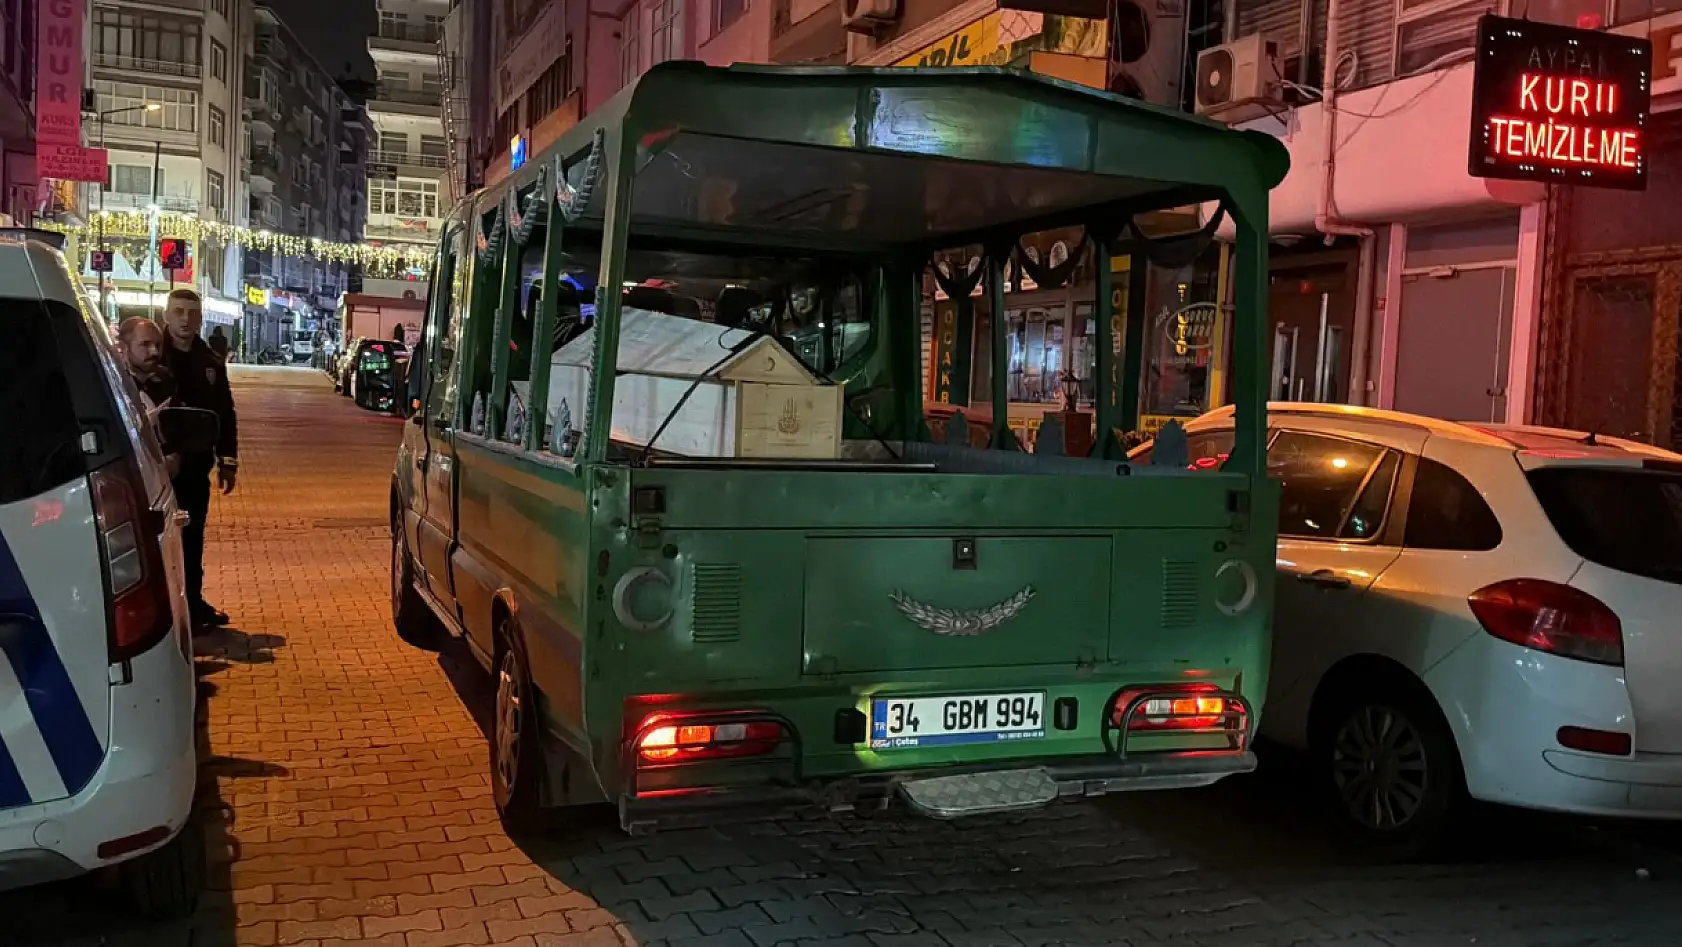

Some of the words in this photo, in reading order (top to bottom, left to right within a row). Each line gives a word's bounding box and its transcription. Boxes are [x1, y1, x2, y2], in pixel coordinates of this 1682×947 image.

[1490, 117, 1637, 167] TEMİZLEME
[889, 703, 920, 734] 34
[943, 699, 989, 731] GBM
[996, 696, 1040, 728] 994
